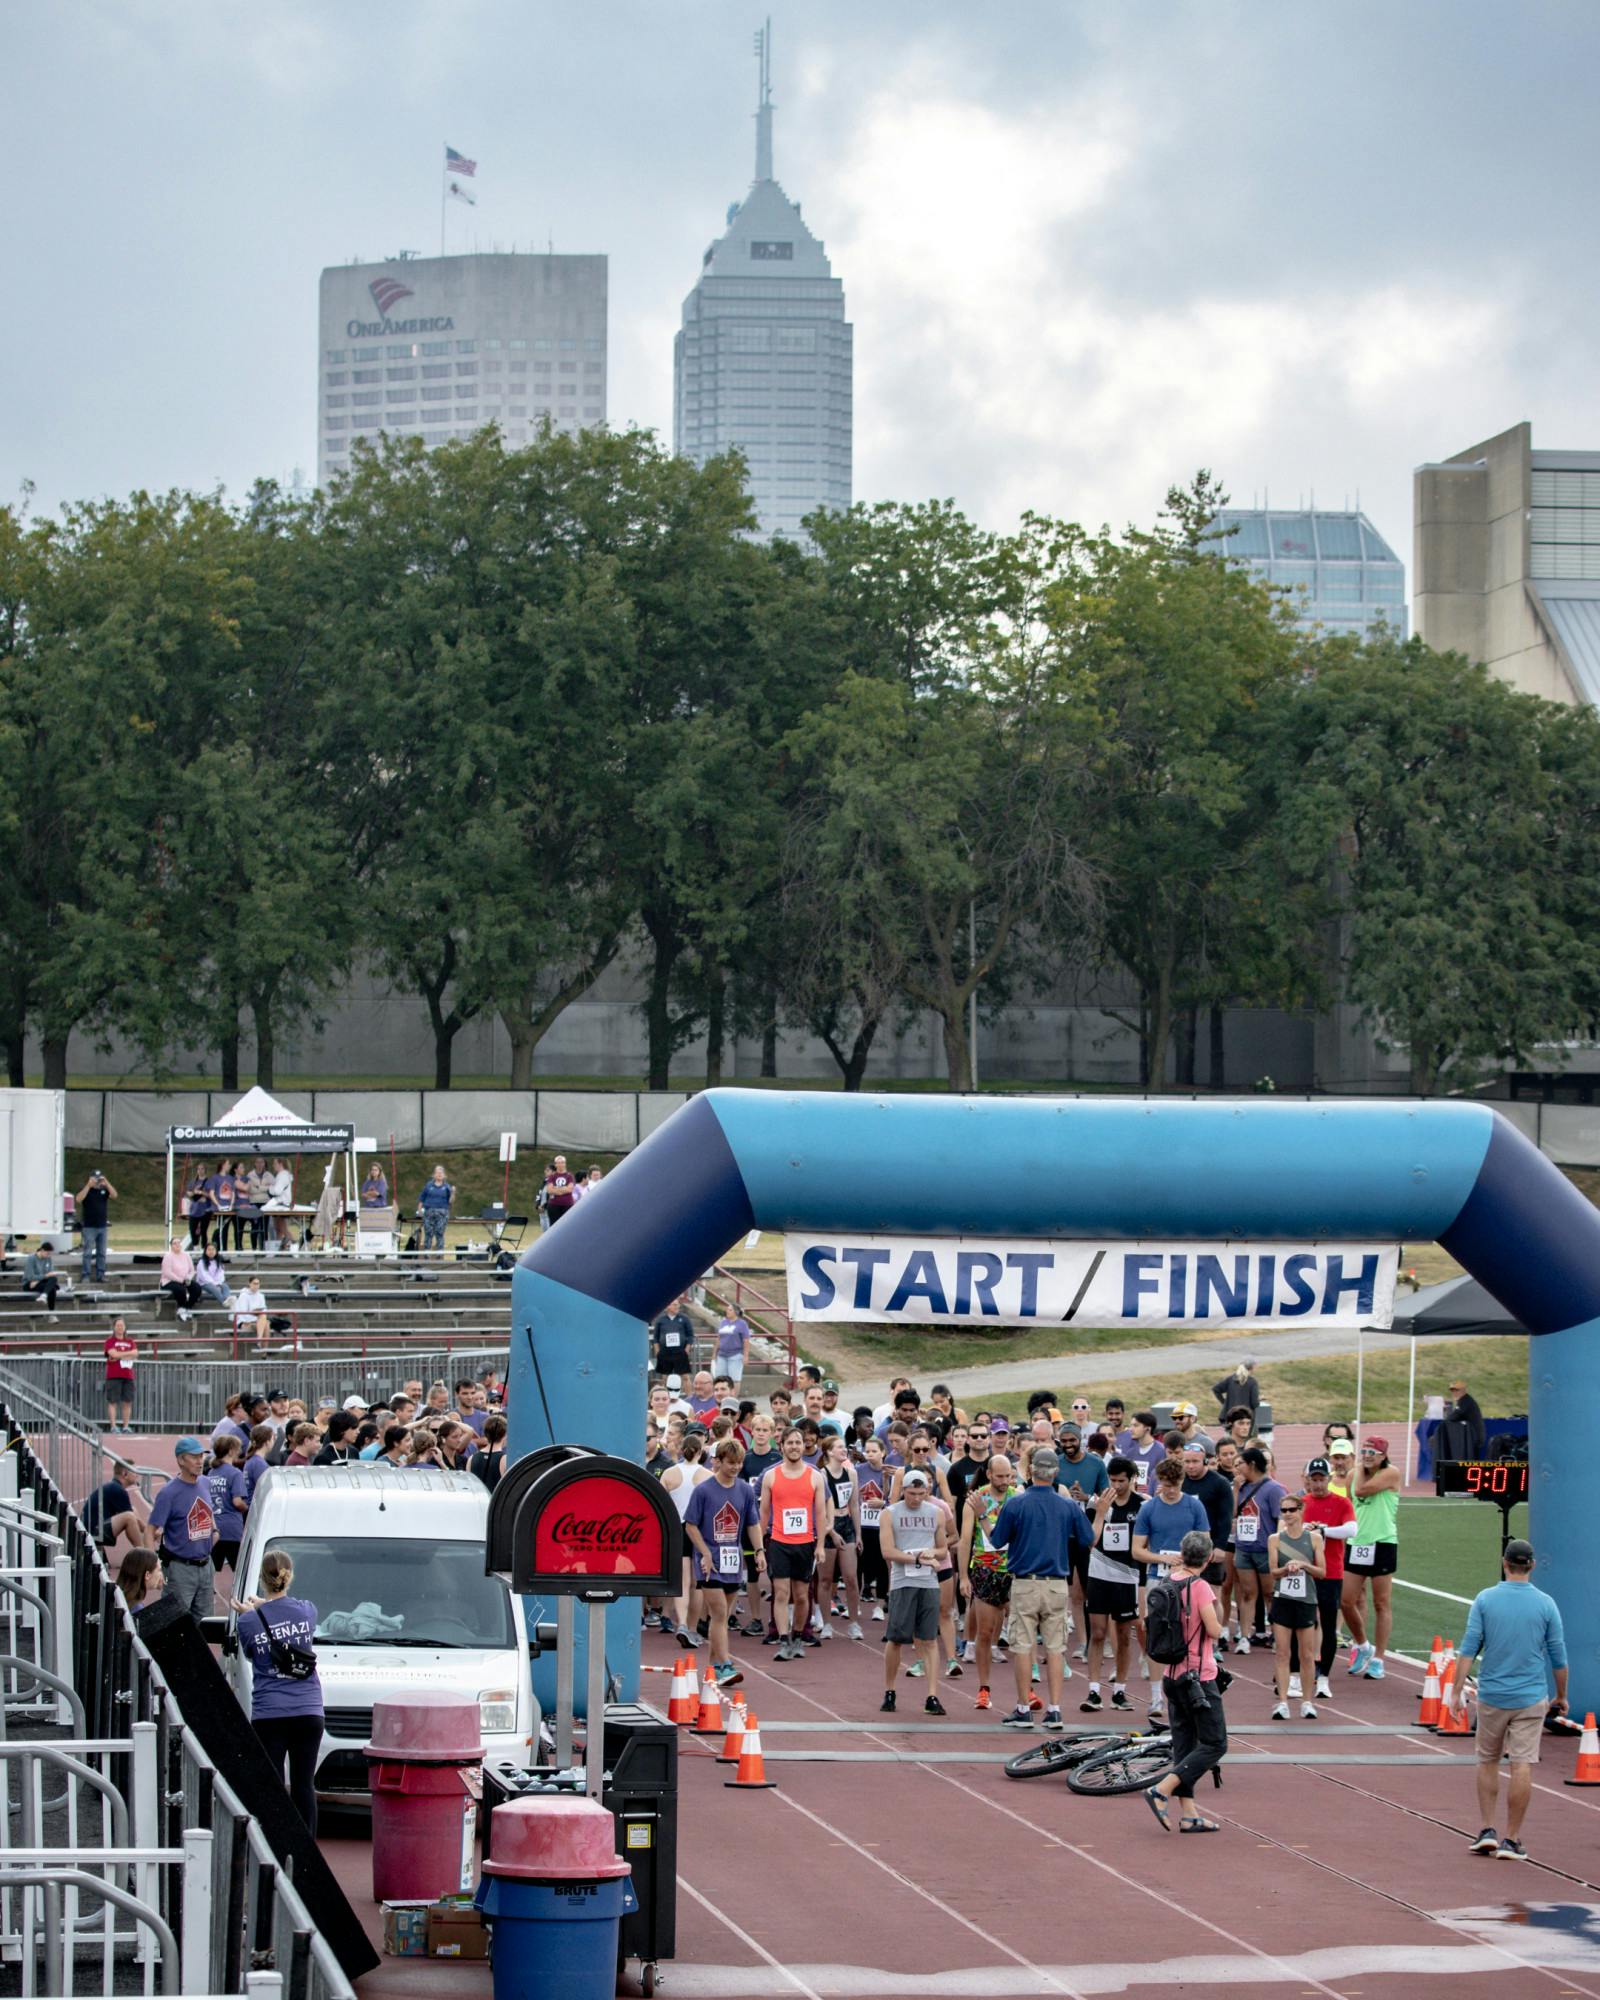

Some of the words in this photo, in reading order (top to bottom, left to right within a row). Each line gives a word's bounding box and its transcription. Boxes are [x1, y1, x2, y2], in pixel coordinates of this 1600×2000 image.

[800, 1245, 1055, 1317] START
[1060, 1250, 1107, 1321] /
[1121, 1253, 1379, 1318] FINISH
[1467, 1467, 1526, 1492] 9:01
[864, 1510, 879, 1520] 107
[789, 1516, 803, 1527] 79
[900, 1516, 935, 1528] IUPUI
[552, 1513, 648, 1544] Coca-Cola
[1239, 1524, 1255, 1535] 135
[1112, 1532, 1120, 1543] 3
[1356, 1547, 1369, 1558] 93
[723, 1555, 738, 1567] 112
[1287, 1578, 1300, 1590] 78
[554, 1885, 598, 1896] BRUTE
